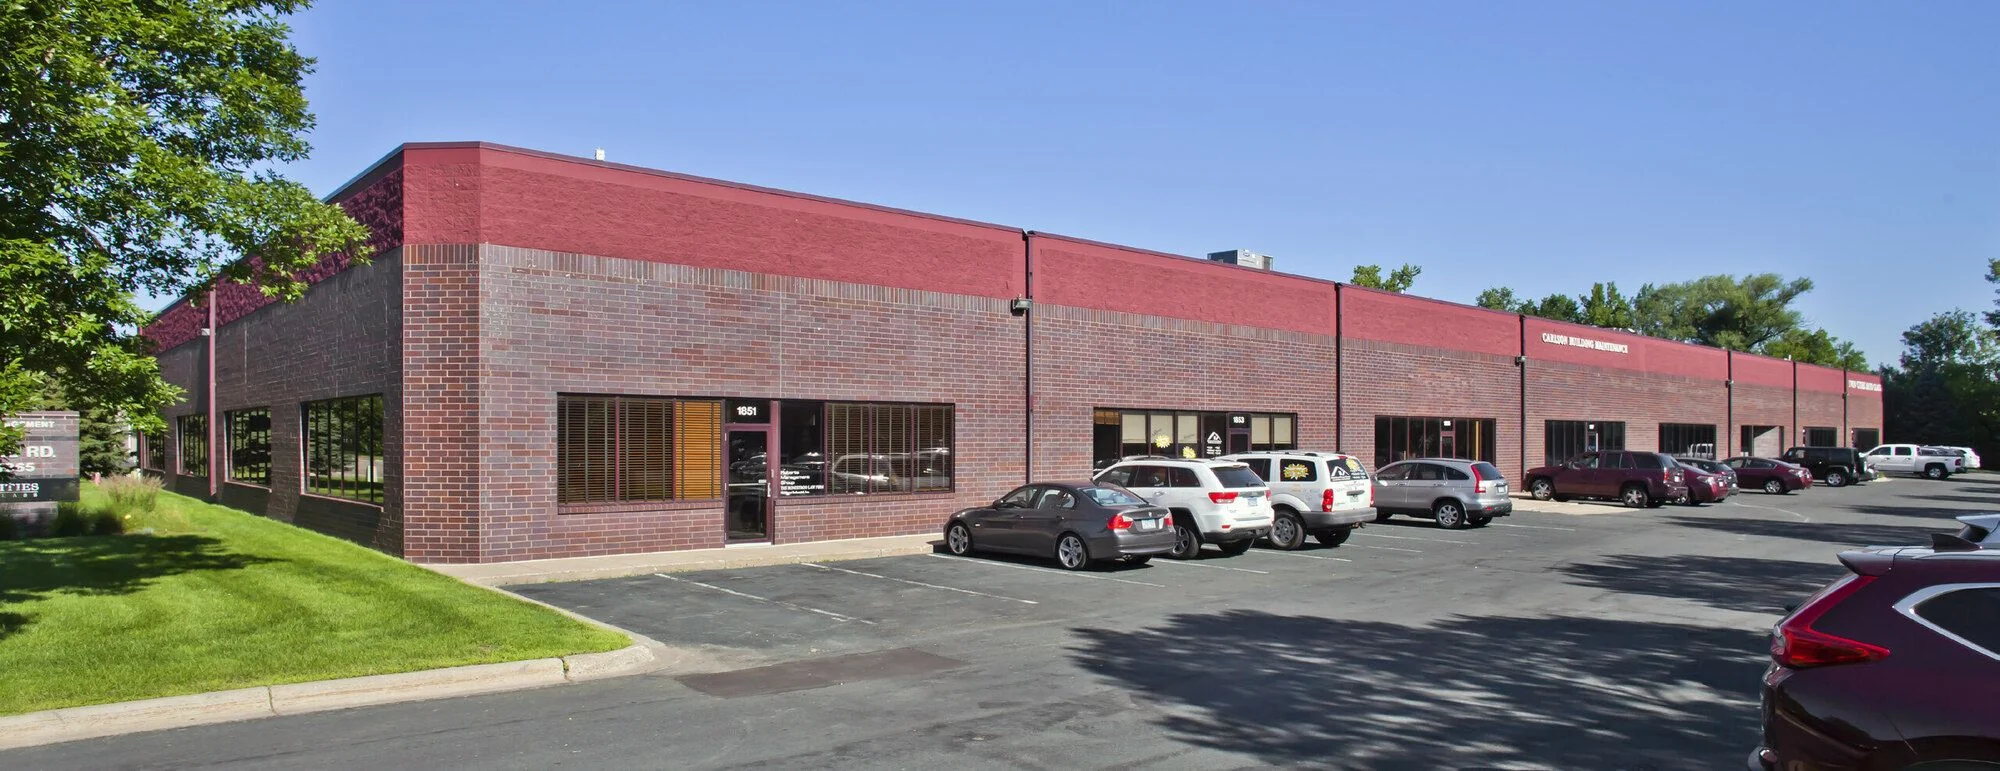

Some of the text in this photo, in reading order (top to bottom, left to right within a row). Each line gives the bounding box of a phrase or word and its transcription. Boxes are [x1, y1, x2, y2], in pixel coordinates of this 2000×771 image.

[1542, 333, 1628, 354] CARLSON BUILDING MAINTENANCE
[736, 406, 757, 416] 1851
[26, 446, 57, 458] RD.
